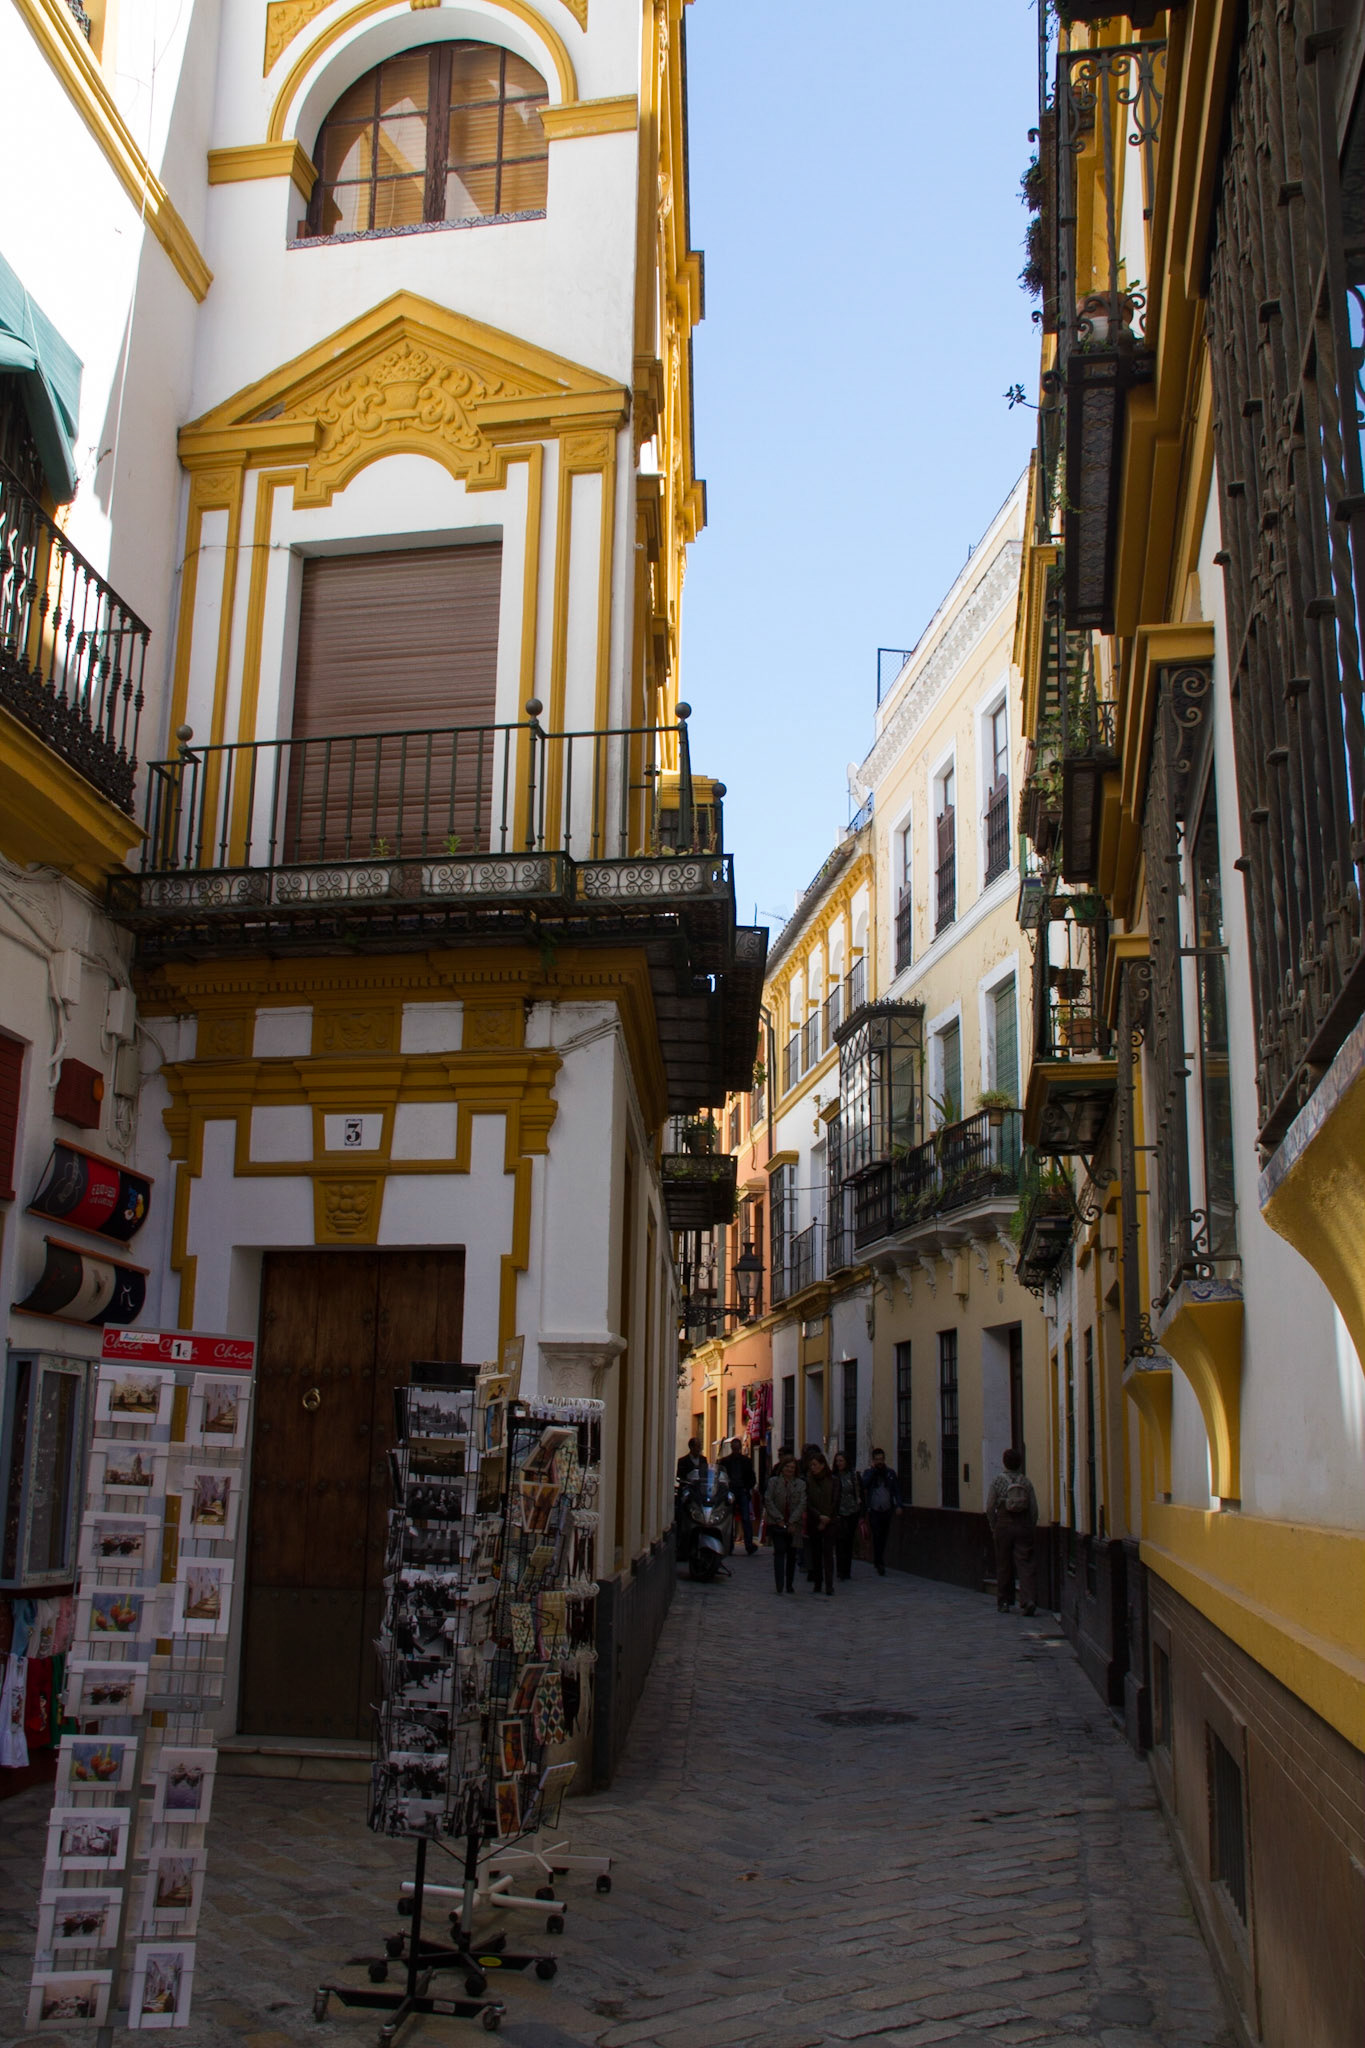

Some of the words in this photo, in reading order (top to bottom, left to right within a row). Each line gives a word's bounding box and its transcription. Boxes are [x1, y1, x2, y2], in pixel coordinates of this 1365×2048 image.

[346, 1123, 361, 1143] 3
[103, 1333, 144, 1351] Chica
[213, 1343, 253, 1359] Chica
